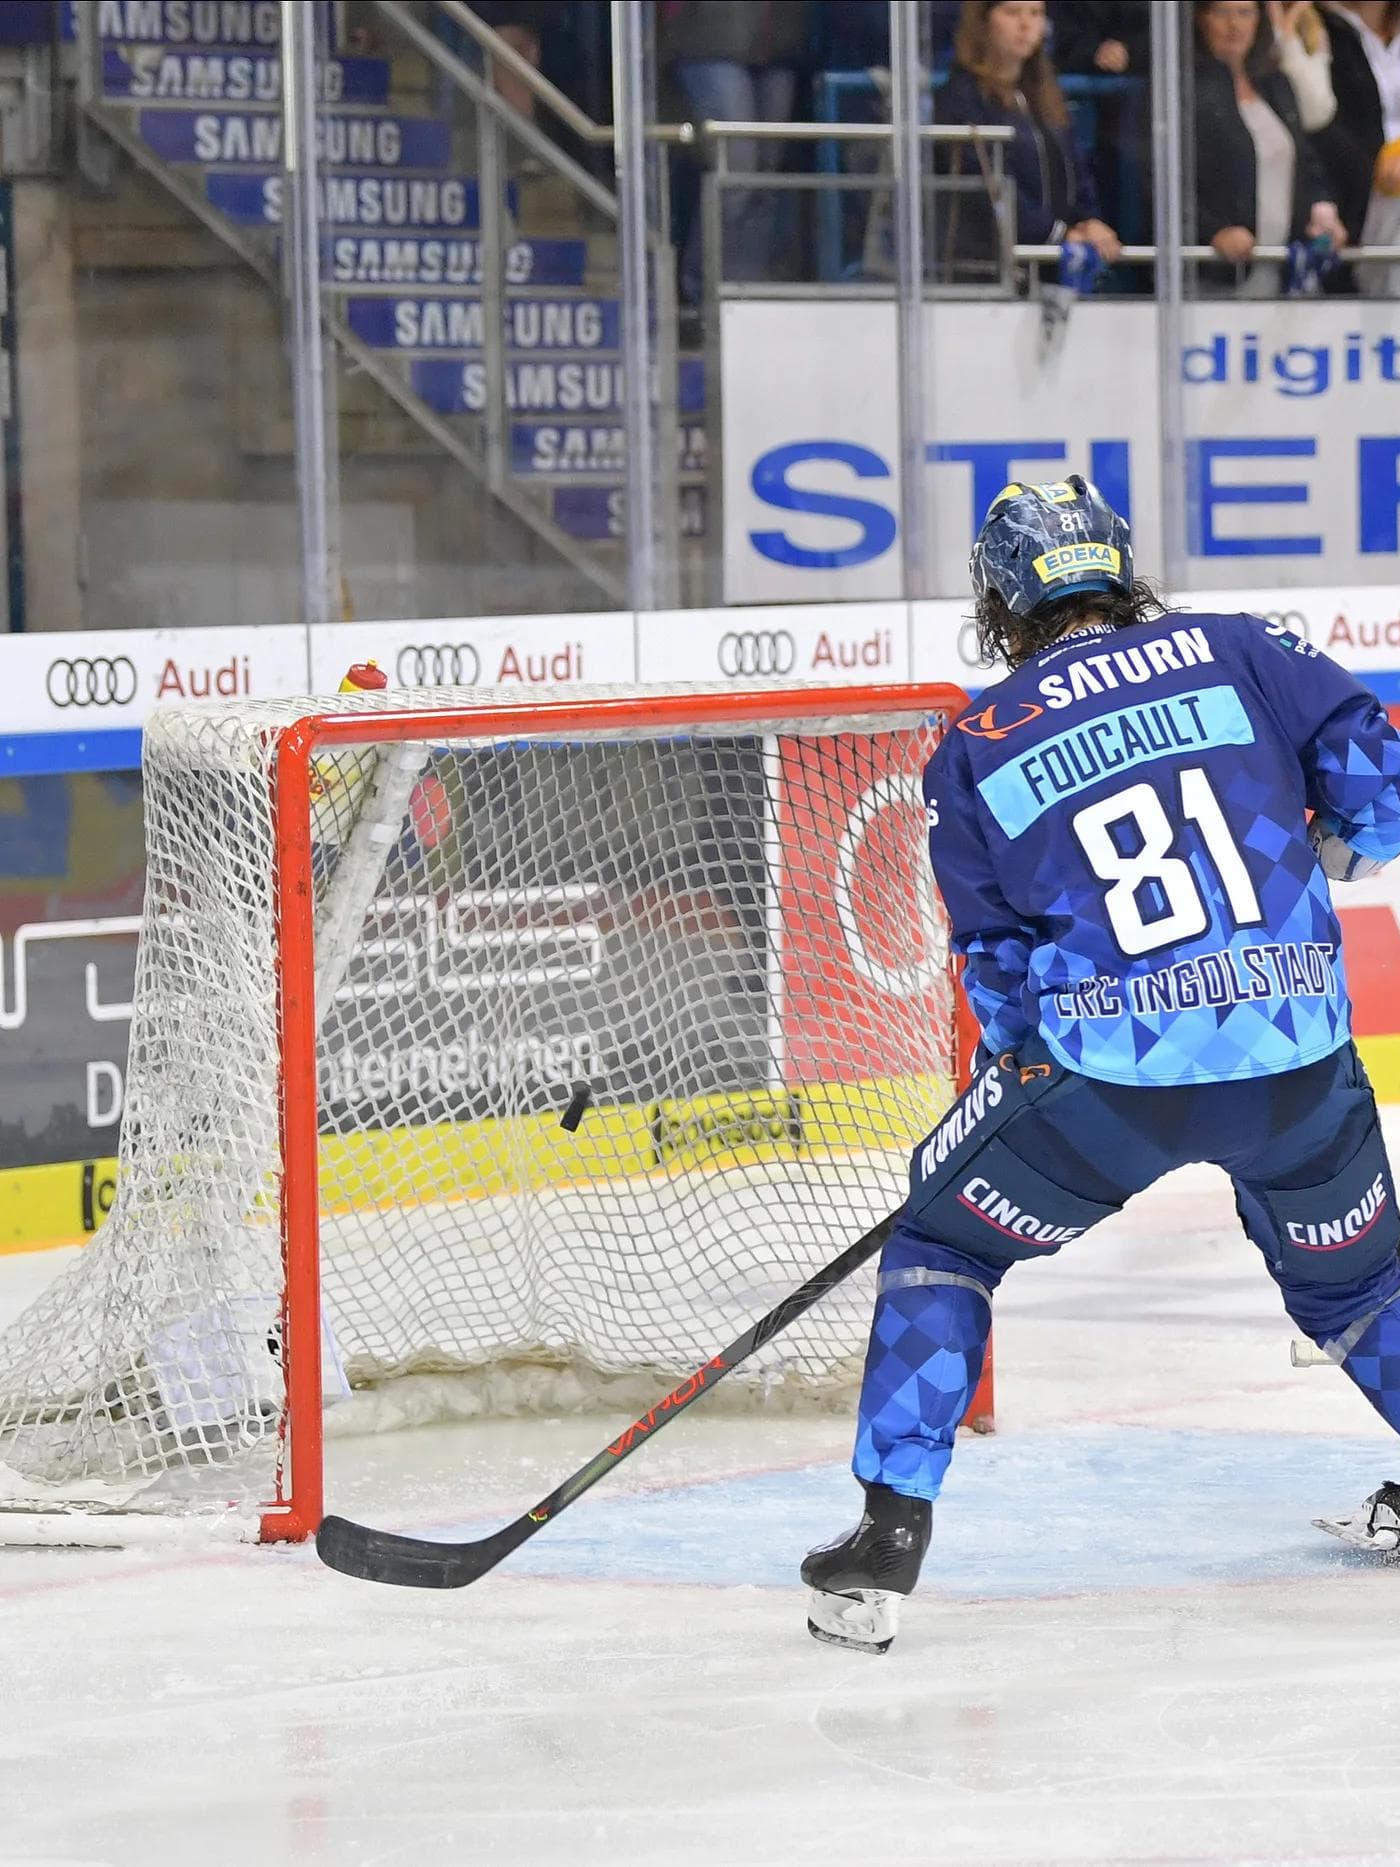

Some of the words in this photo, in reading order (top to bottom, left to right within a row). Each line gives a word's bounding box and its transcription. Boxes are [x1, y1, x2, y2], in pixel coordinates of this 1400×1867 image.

[73, 0, 281, 42] AMSUNG
[128, 55, 343, 99] SAMSUG
[194, 114, 400, 163] SAMUNG
[334, 238, 534, 283] SAMSUG
[395, 299, 602, 347] SAMUNG
[1060, 512, 1083, 532] 81
[1043, 546, 1112, 571] EDEKA
[498, 643, 583, 684] Audi
[811, 629, 892, 670] Audi
[1038, 627, 1215, 709] SATURN
[157, 658, 250, 698] Audi
[1019, 696, 1210, 806] FOUCAULT
[1072, 767, 1263, 957] 81
[1133, 942, 1338, 1015] INGOLSTADT
[921, 1066, 1003, 1182] SATURN
[962, 1177, 1088, 1242] CINQUE
[1286, 1173, 1387, 1246] CINQUE
